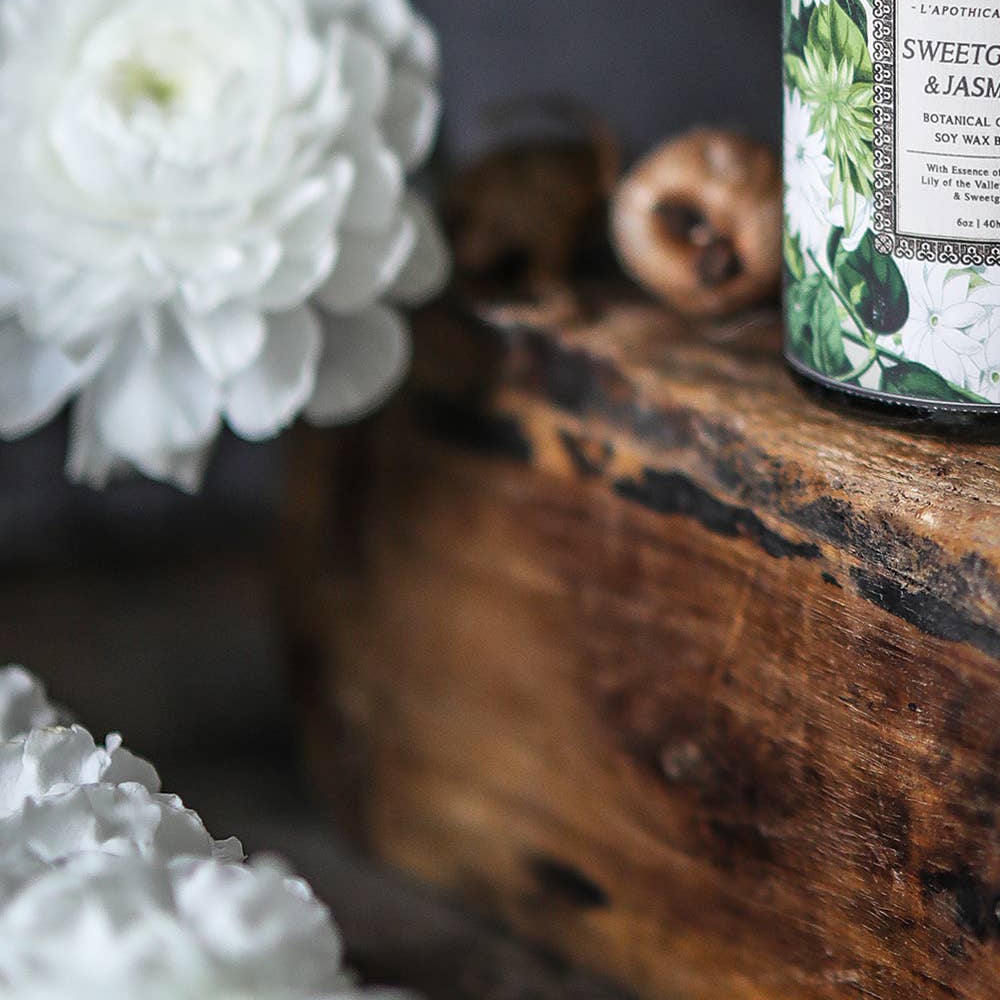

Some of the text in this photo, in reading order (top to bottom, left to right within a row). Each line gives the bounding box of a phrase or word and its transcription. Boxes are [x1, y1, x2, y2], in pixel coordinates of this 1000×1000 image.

[923, 112, 992, 128] BOTANICAL
[934, 132, 959, 144] SOY
[962, 134, 991, 146] WAX
[926, 163, 949, 174] With
[951, 165, 989, 177] Essence
[921, 175, 940, 188] Lily
[942, 177, 953, 187] of
[955, 179, 971, 189] the
[956, 217, 974, 228] 6oz
